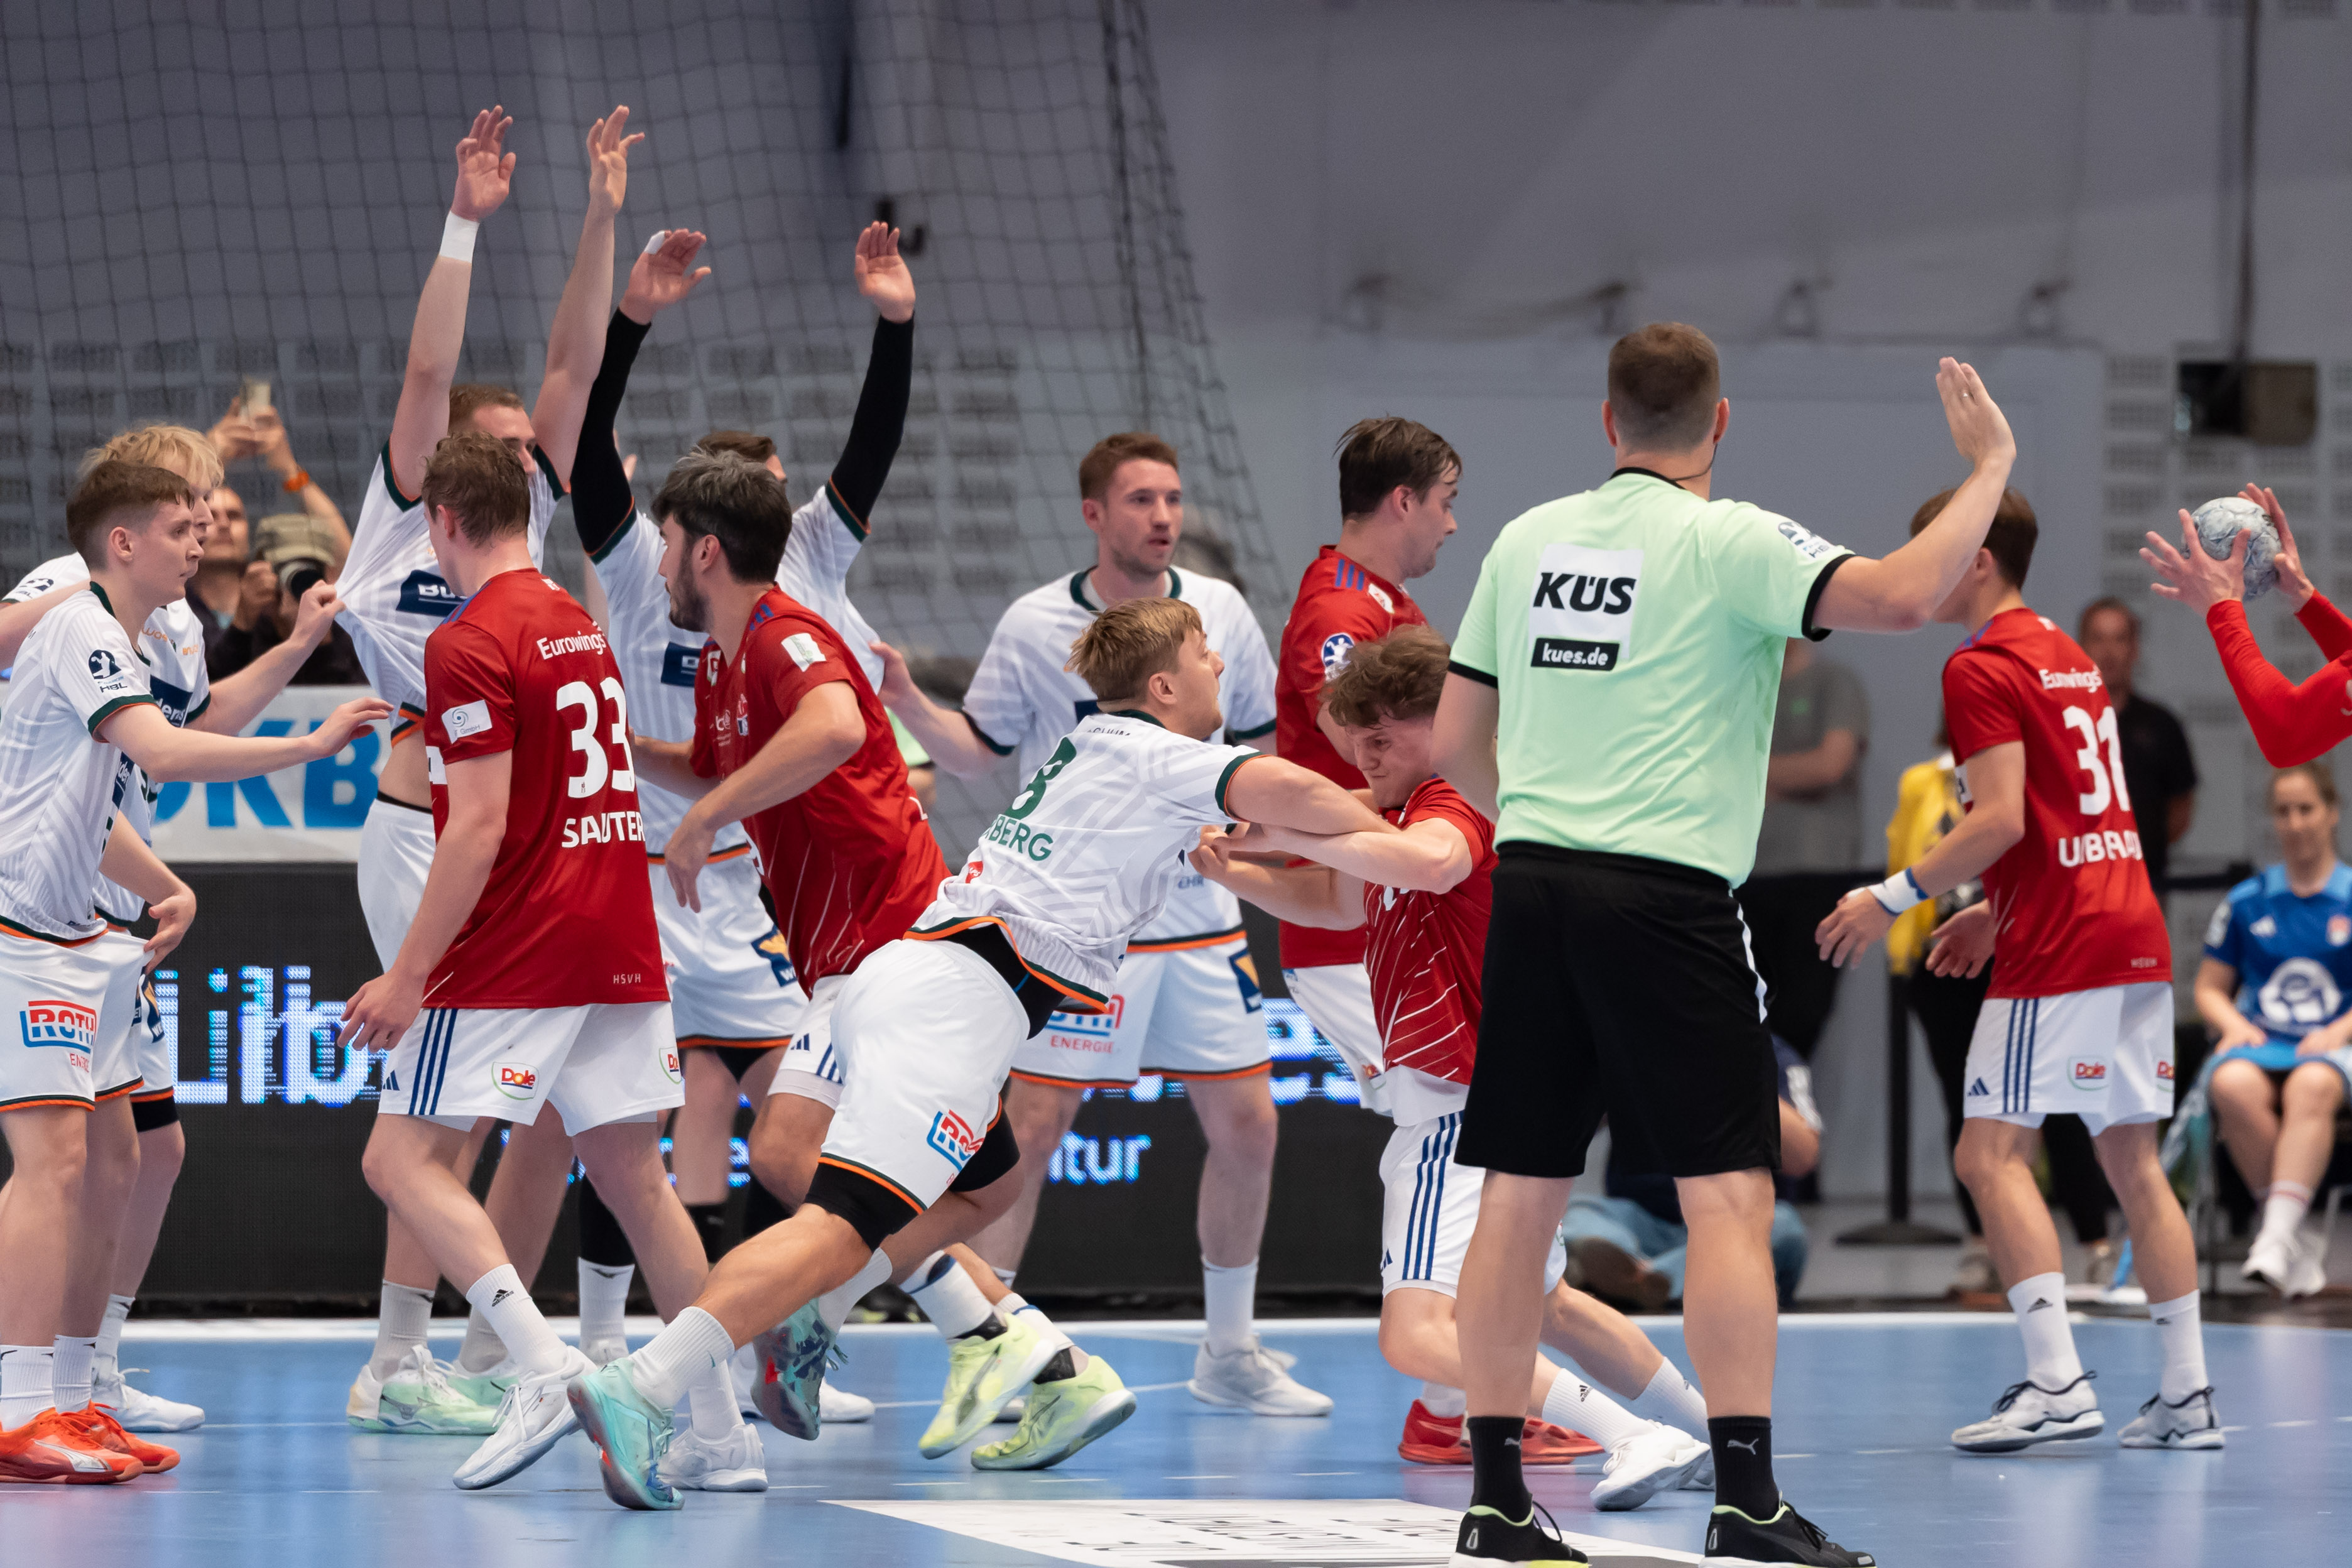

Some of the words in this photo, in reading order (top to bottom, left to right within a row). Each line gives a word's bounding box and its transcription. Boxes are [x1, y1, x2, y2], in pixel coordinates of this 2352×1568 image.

[1533, 572, 1637, 615] KÜS
[536, 630, 606, 660] Eurowings
[1542, 642, 1608, 666] kues.de
[99, 682, 128, 693] HBL
[556, 677, 635, 798] 33
[151, 719, 381, 829] KB
[2062, 705, 2130, 815] 31
[561, 811, 646, 849] SAUTER
[981, 815, 1054, 861] BERG
[612, 973, 641, 984] HSVH
[501, 1067, 536, 1086] Dole
